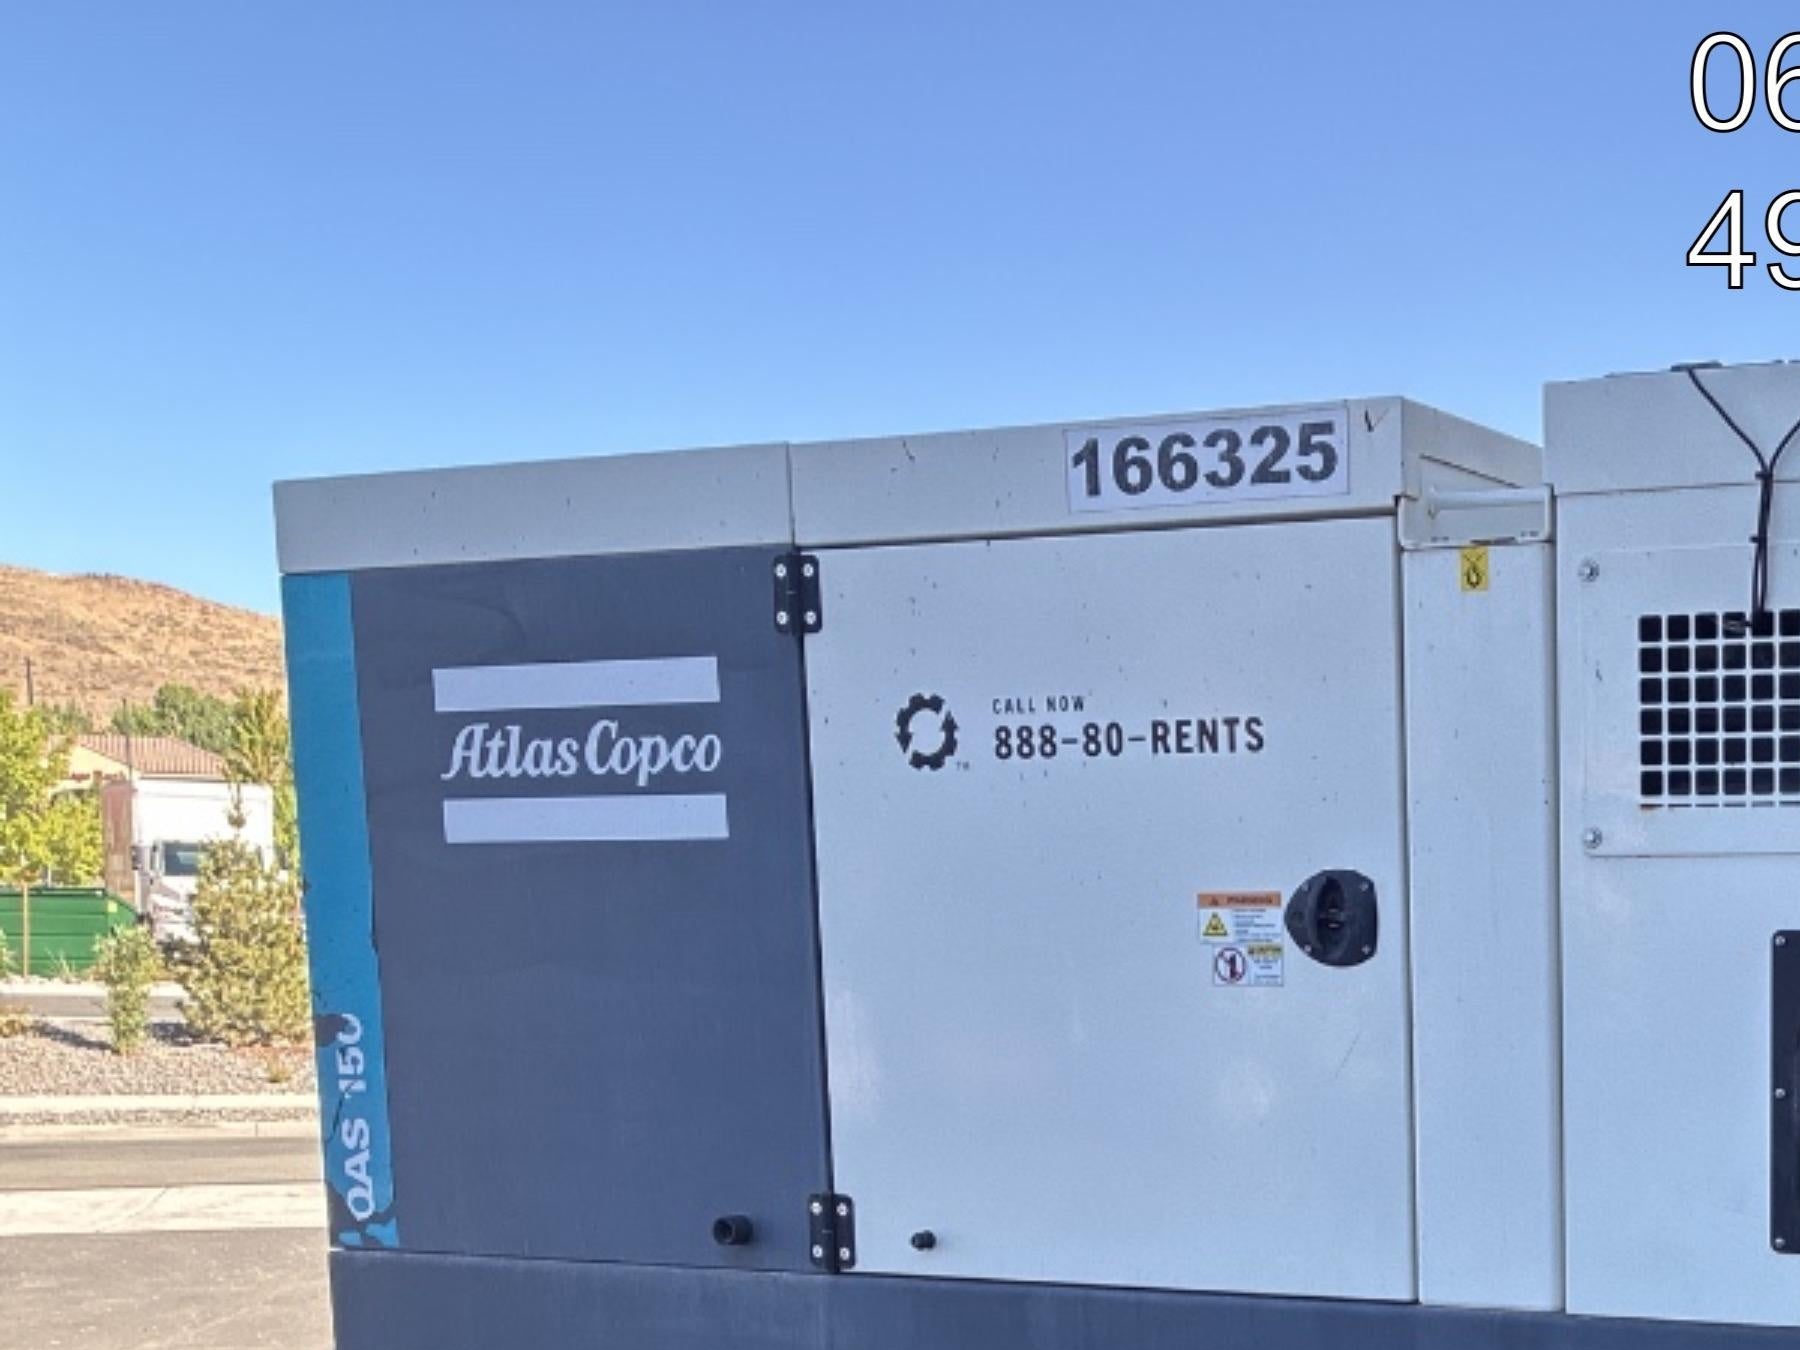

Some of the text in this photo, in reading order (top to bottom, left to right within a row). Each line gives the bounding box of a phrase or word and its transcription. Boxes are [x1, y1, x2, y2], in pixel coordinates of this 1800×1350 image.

[1072, 421, 1339, 498] 166325
[992, 695, 1085, 715] CALL NOW
[994, 716, 1266, 760] 888-80-RENTS
[440, 719, 723, 787] Atlas Copco
[344, 1117, 376, 1222] QAS
